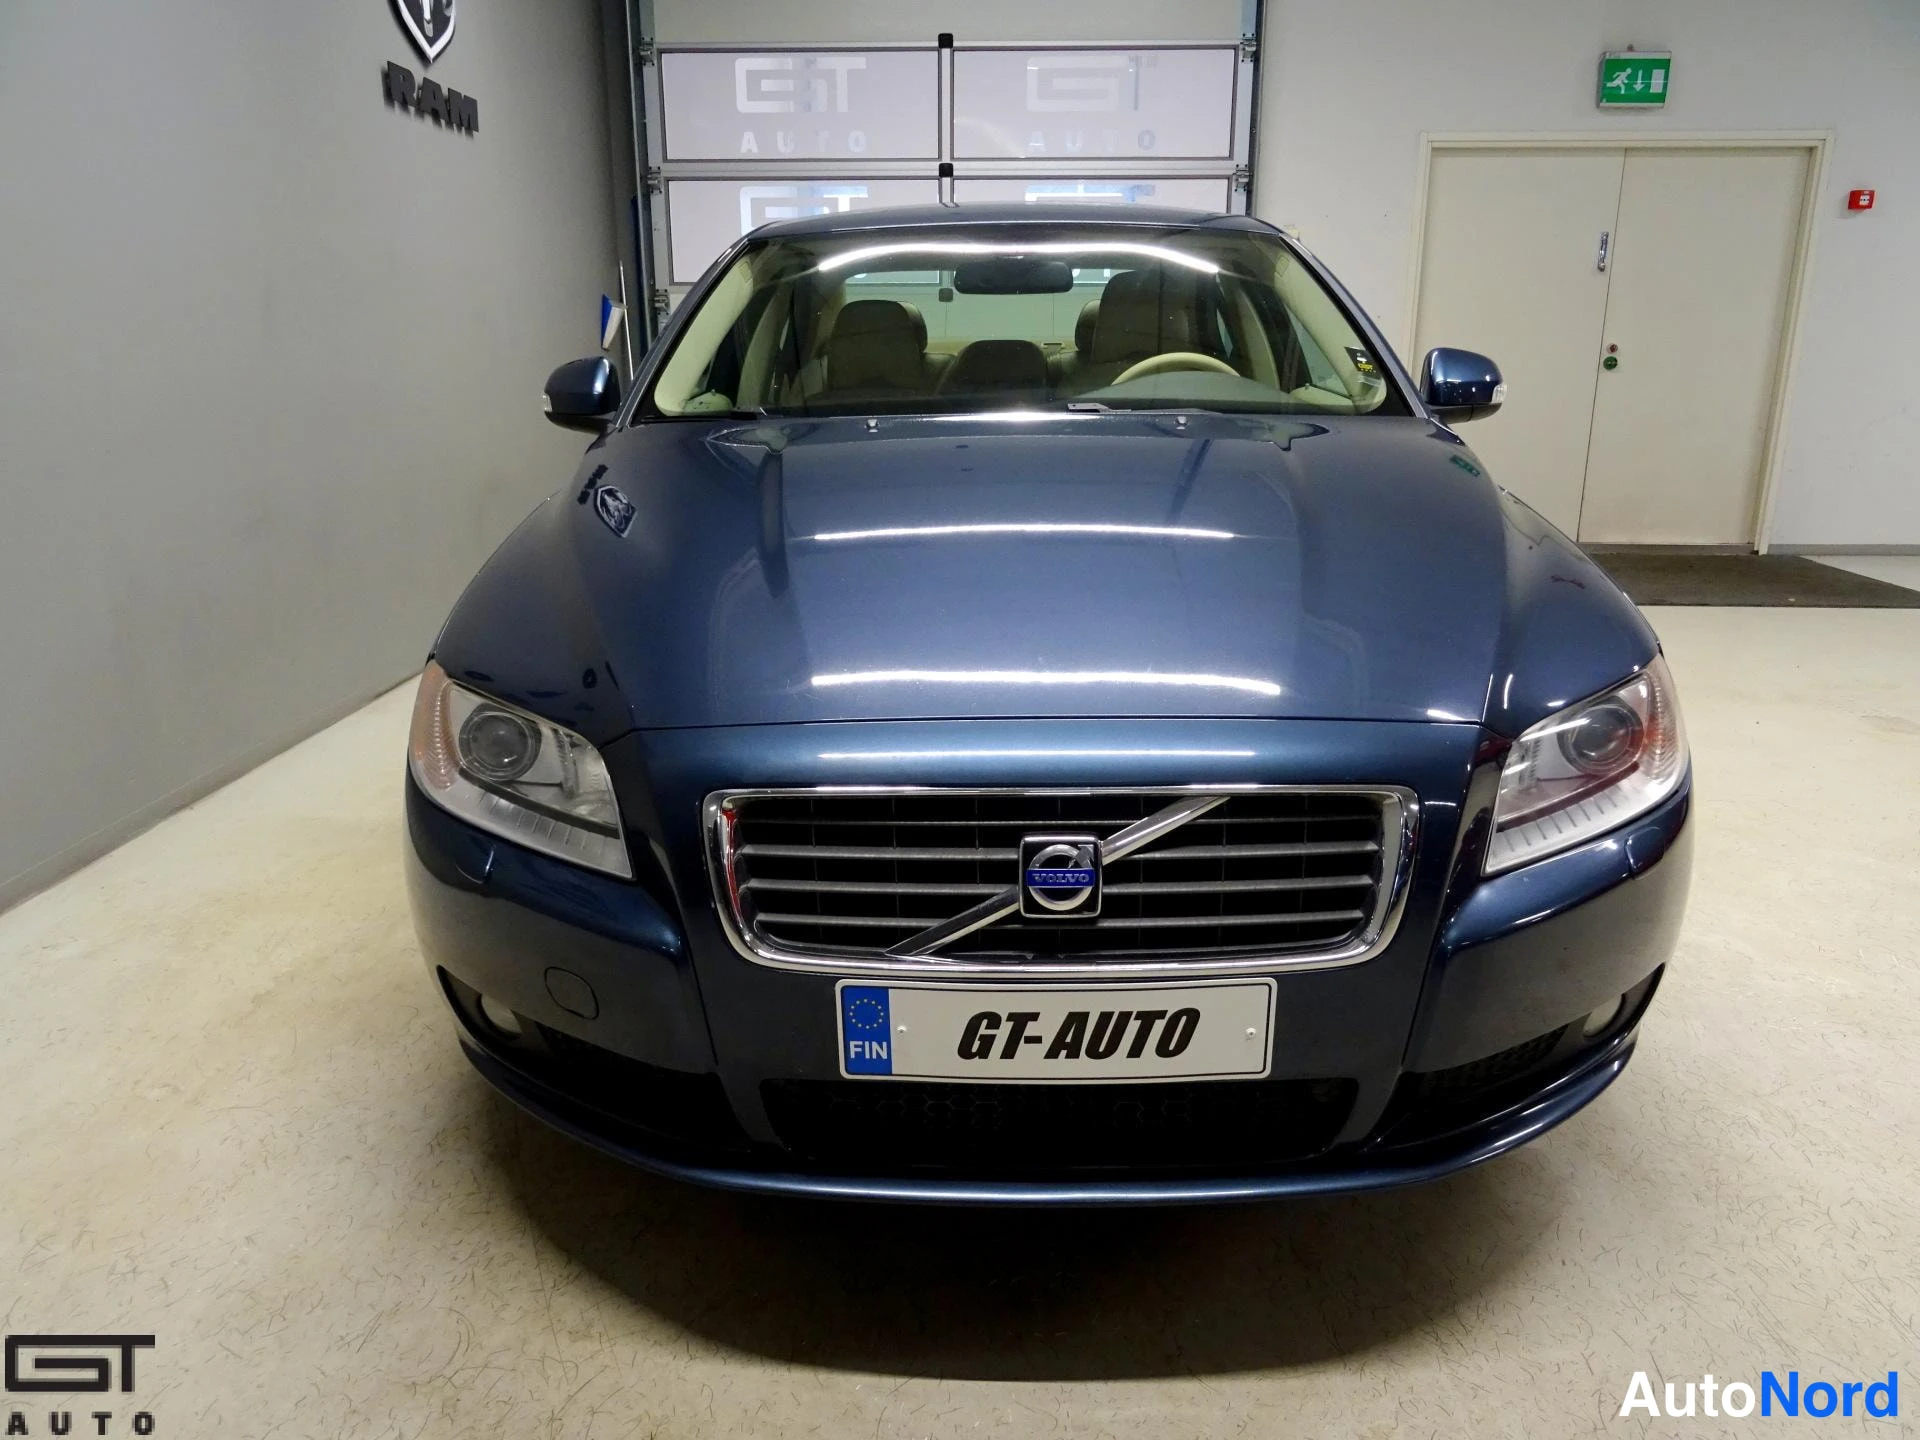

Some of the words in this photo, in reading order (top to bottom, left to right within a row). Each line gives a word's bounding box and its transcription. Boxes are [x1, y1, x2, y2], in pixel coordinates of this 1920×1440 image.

[387, 61, 479, 132] RAM
[740, 131, 867, 153] AUTO
[1032, 873, 1090, 883] VOLVO
[957, 1007, 1201, 1060] GT-AUTO
[849, 1040, 888, 1060] FIN
